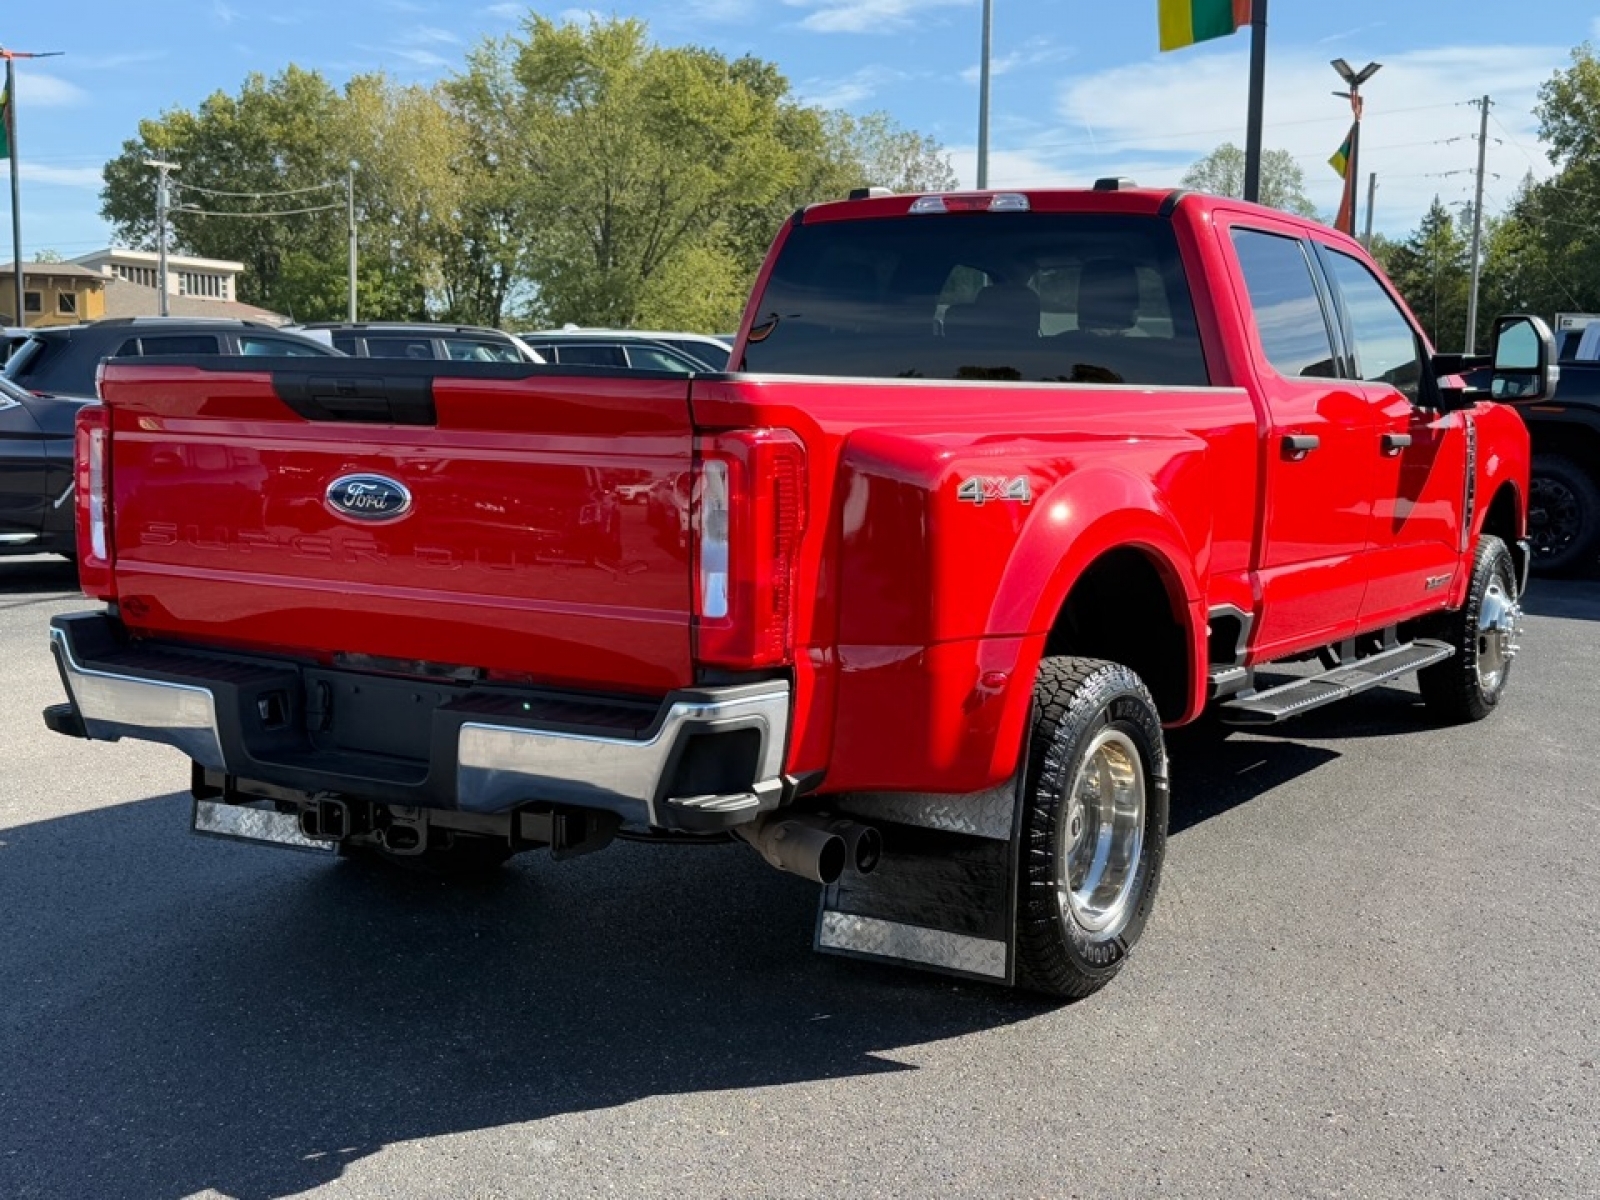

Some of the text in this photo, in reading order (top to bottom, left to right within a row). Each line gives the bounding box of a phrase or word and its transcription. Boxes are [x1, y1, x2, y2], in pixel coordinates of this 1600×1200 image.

[343, 482, 389, 509] Ford
[139, 521, 649, 585] SUPER DUTY
